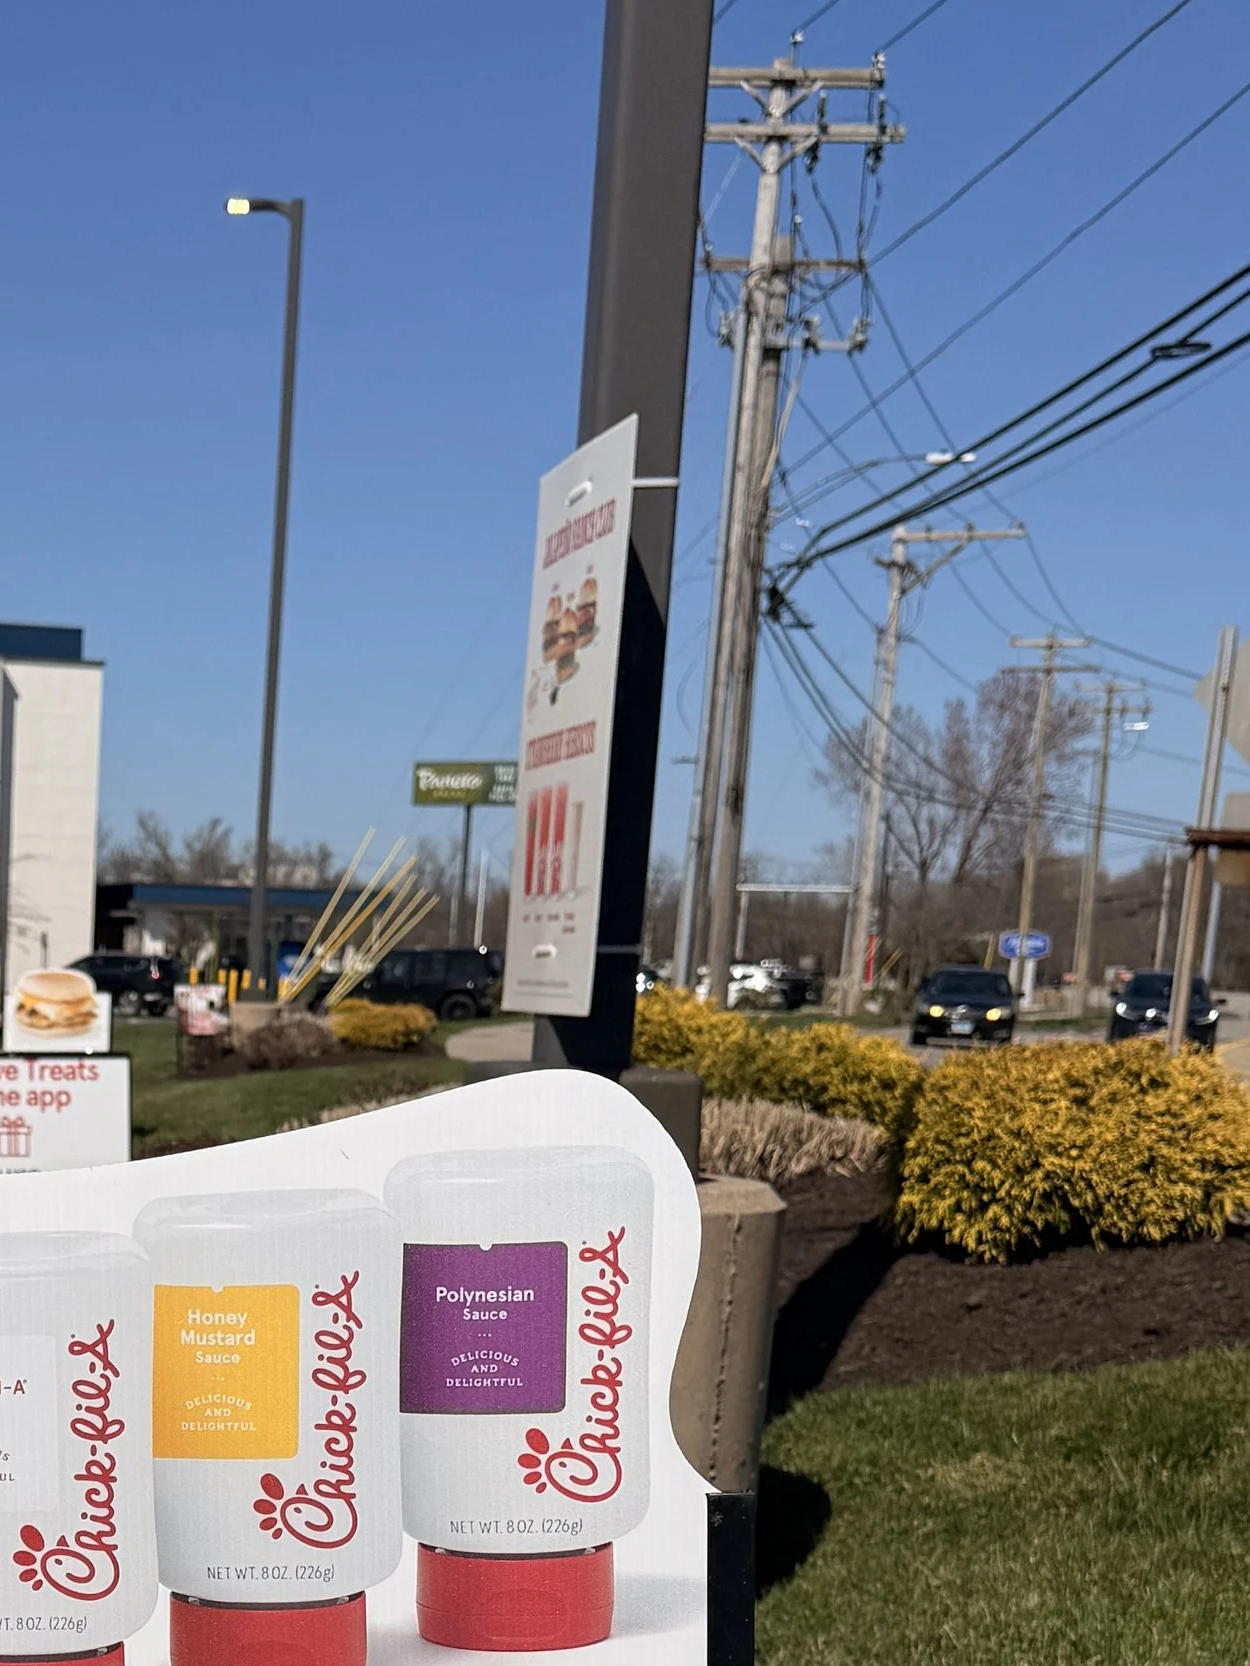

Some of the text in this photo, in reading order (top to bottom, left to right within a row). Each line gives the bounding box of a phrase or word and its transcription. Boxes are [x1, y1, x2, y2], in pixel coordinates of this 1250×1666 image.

[24, 1057, 99, 1082] Treats
[26, 1087, 72, 1113] app
[435, 1287, 534, 1305] Polynesian
[187, 1310, 248, 1328] Honey
[462, 1308, 508, 1320] Sauce
[180, 1328, 256, 1346] Mustard
[195, 1350, 240, 1366] Sauce
[450, 1350, 520, 1369] DELICIOUS
[545, 1226, 632, 1503] Chick-fil-A
[471, 1363, 497, 1374] AND
[446, 1377, 524, 1388] DELIGHTFUL
[185, 1394, 253, 1411] DELICIOUS
[281, 1270, 367, 1549] Chick-fil-A
[205, 1406, 231, 1419] AND
[180, 1421, 256, 1432] DELIGHTFUL
[41, 1319, 126, 1601] Chick-fil-A
[450, 1520, 474, 1534] NET
[478, 1520, 504, 1534] WT.
[506, 1519, 515, 1534] 8
[541, 1517, 583, 1537] (226g)
[207, 1566, 230, 1580] NET
[234, 1566, 260, 1580] WT.
[261, 1566, 270, 1580] 8
[295, 1563, 335, 1583] (226g)
[16, 1617, 24, 1631] 8
[48, 1615, 87, 1634] (226g)
